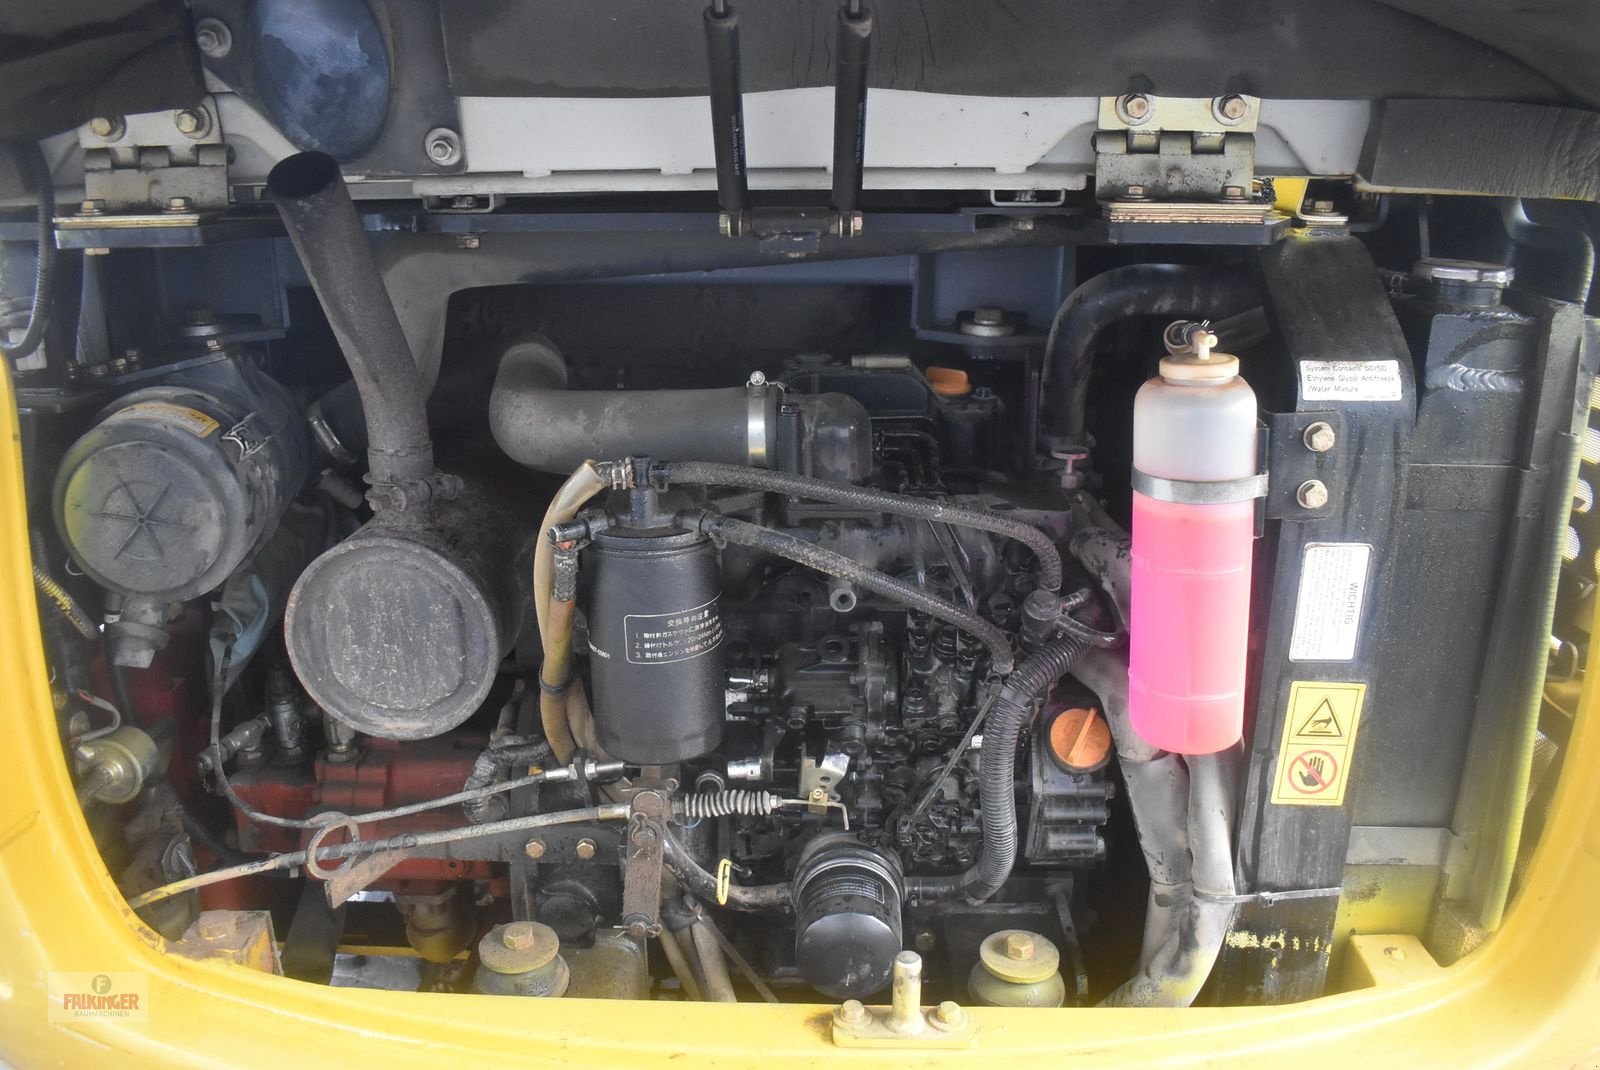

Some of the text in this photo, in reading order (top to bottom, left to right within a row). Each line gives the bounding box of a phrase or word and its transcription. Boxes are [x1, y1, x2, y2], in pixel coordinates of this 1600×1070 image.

[1306, 374, 1336, 382] Ethylene
[1338, 374, 1359, 382] Glycol
[1344, 582, 1359, 625] WICHTIG
